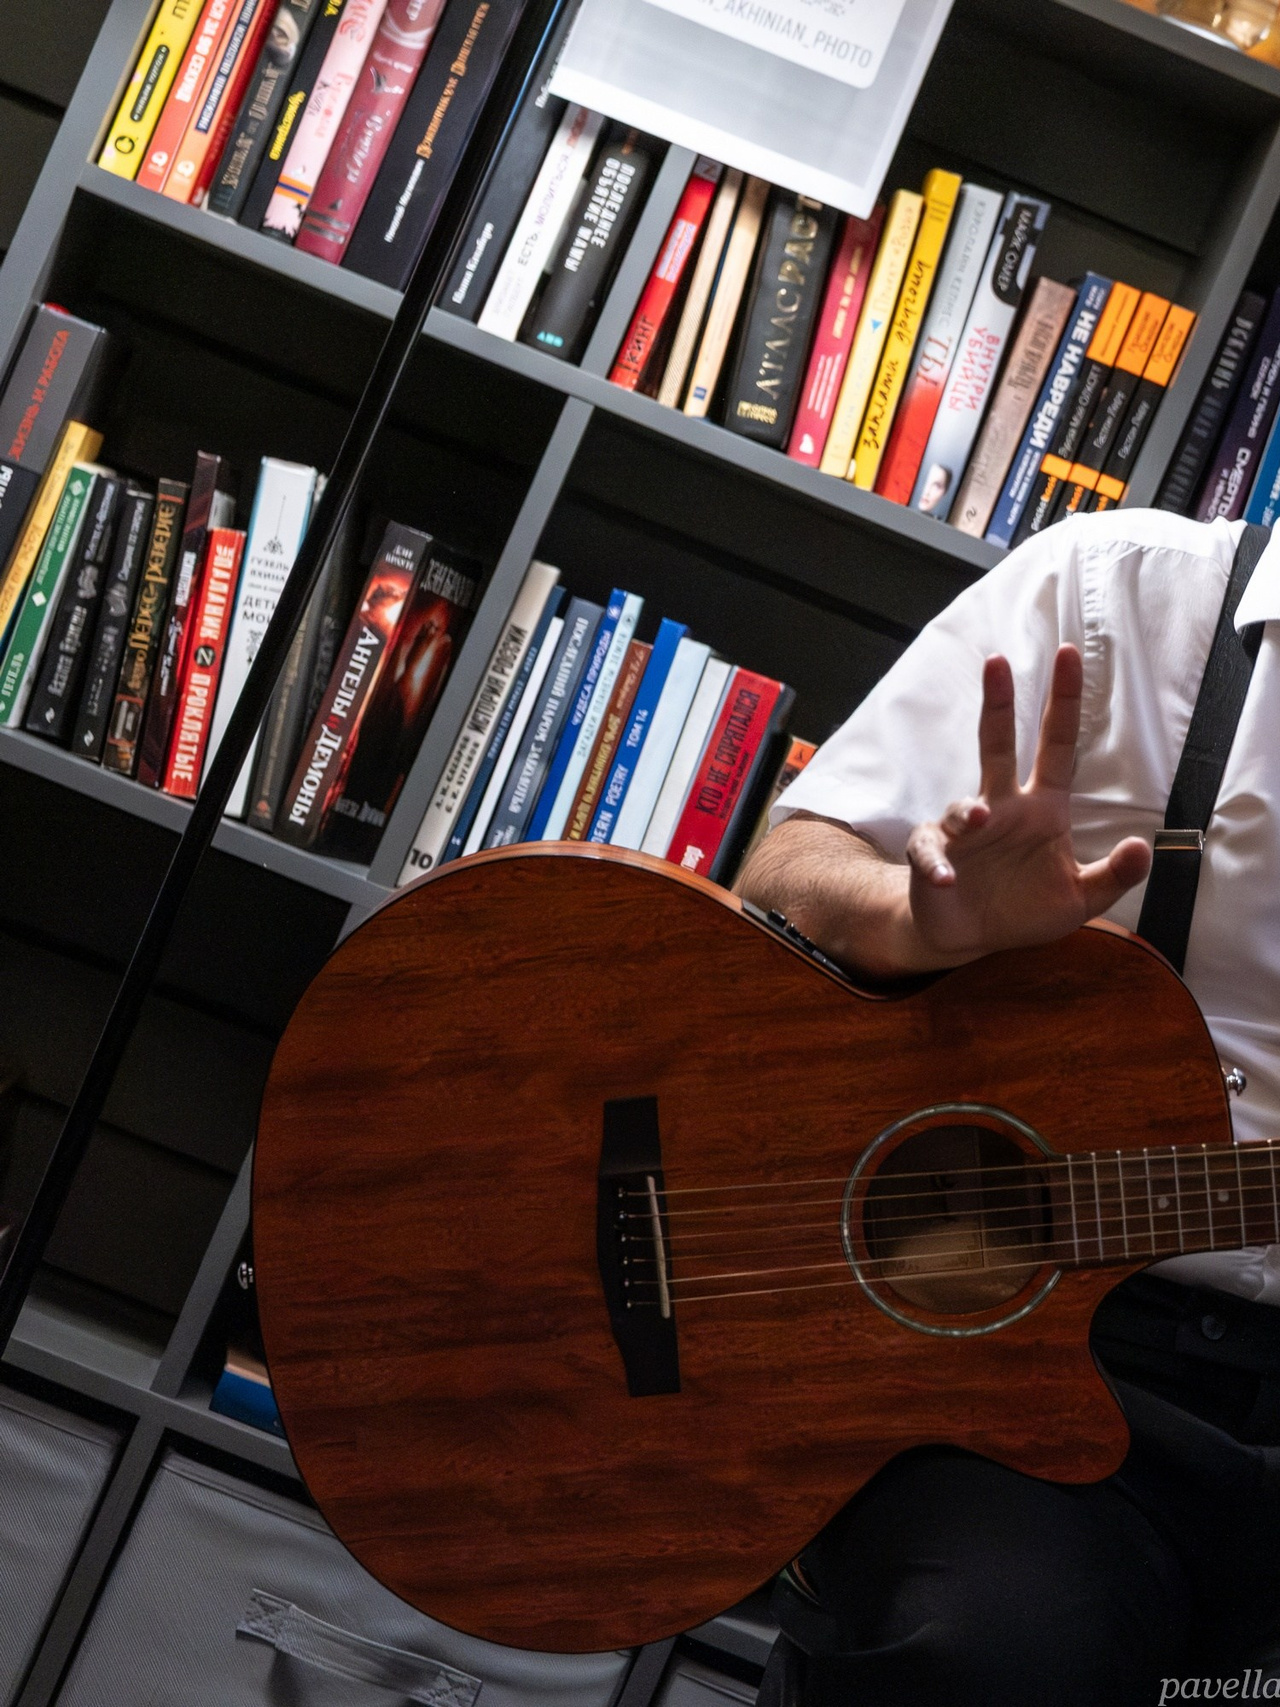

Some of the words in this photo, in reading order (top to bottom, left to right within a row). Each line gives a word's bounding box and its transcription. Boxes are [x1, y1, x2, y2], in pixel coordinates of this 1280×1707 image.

[703, 0, 873, 68] _AKHINIAN_PHOTO
[583, 155, 621, 224] ОБЪЯТИЕ
[590, 161, 637, 249] ПОСЛЕДНЕЕ
[562, 224, 593, 272] МАМЫ
[776, 192, 823, 290] РАСТ
[624, 313, 655, 366] КИНГ
[754, 285, 802, 400] АТЛАС
[912, 328, 954, 389] ТЫ
[1068, 308, 1096, 345] НЕ
[8, 401, 41, 461] ЖИЗНЬ
[37, 327, 70, 387] РАБОТА
[944, 323, 988, 412] УБИЙЦЫ
[963, 332, 1000, 413] ВНУТРИ
[1025, 341, 1084, 450] НАВРЕДИ
[198, 554, 233, 644] ПАЛАНИК
[250, 556, 290, 573] ГУЗЕЛЬ
[250, 569, 286, 583] ЯХИНА
[329, 626, 381, 719] АНГЕЛЫ
[466, 674, 505, 735] ИСТОРИЯ
[490, 622, 528, 678] РОССИИ
[569, 681, 594, 726] ЧУДЕСА
[585, 629, 613, 683] ПРИРОДЫ
[173, 668, 213, 785] ПРОКЛЯТЫЕ
[625, 721, 644, 749] ТОМ
[712, 686, 761, 767] СПРЯТАЛСЯ
[284, 724, 342, 826] ДЕМОНЫ
[591, 809, 614, 844] DERN
[605, 763, 630, 806] POETRY
[694, 783, 723, 816] КТО
[704, 762, 732, 787] НЕ
[410, 848, 433, 870] 10
